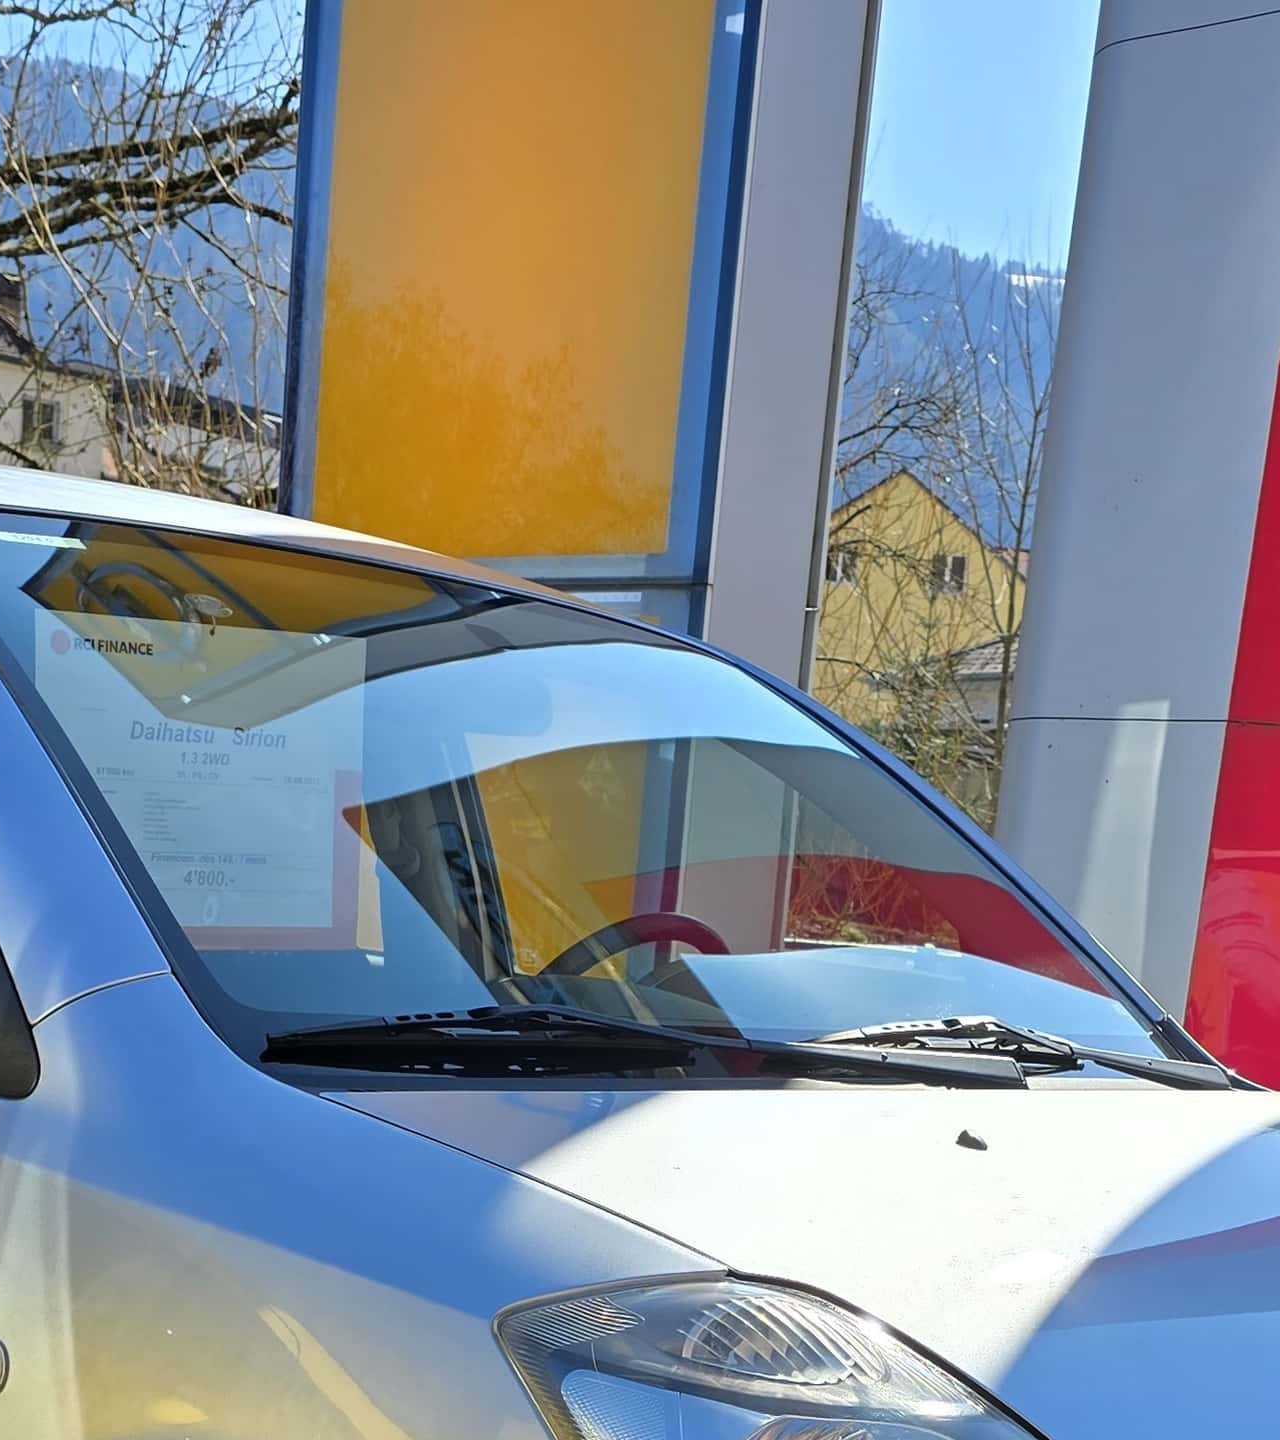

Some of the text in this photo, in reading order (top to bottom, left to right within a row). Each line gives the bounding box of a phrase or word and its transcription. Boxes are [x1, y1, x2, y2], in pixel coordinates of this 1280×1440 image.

[74, 637, 154, 656] RCI FINANCE
[129, 720, 287, 748] Daihatsu Sirion
